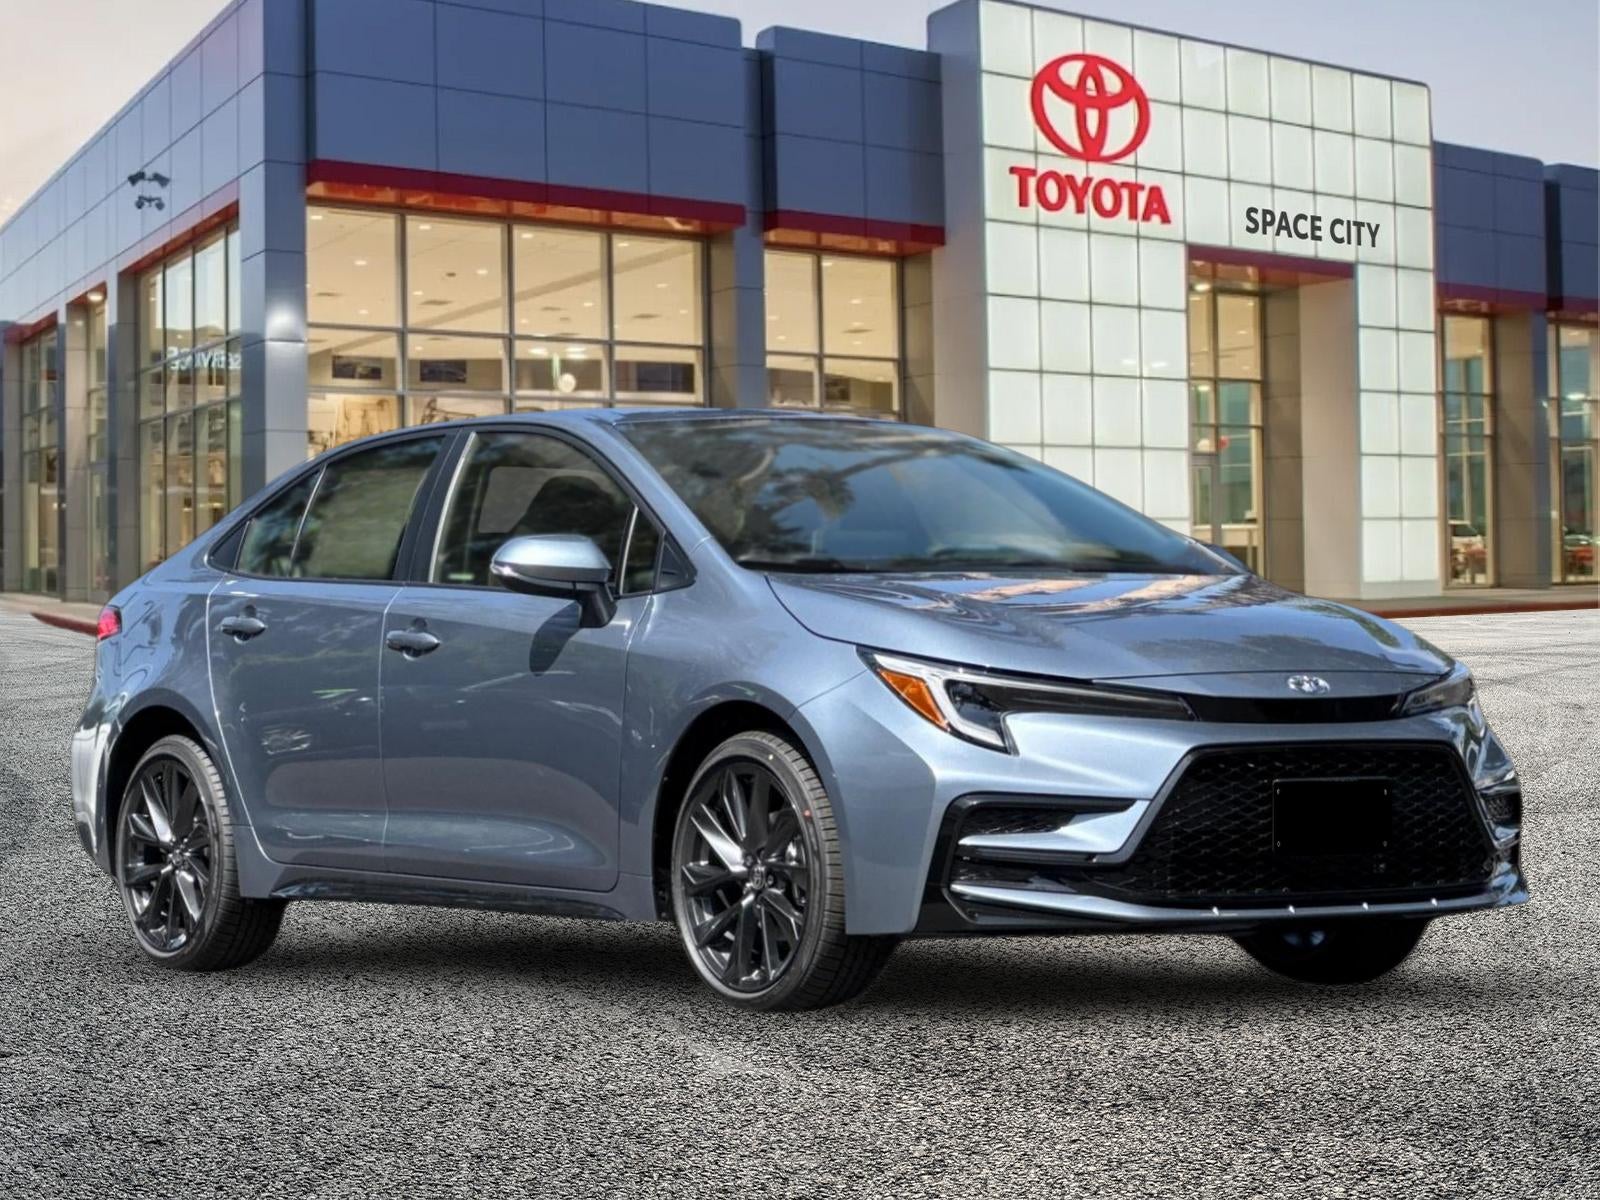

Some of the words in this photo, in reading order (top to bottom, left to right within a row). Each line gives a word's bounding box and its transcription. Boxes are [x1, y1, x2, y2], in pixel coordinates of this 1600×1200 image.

[1009, 166, 1171, 225] TOYOTA
[1245, 206, 1323, 242] SPACE
[1329, 217, 1380, 248] CITY
